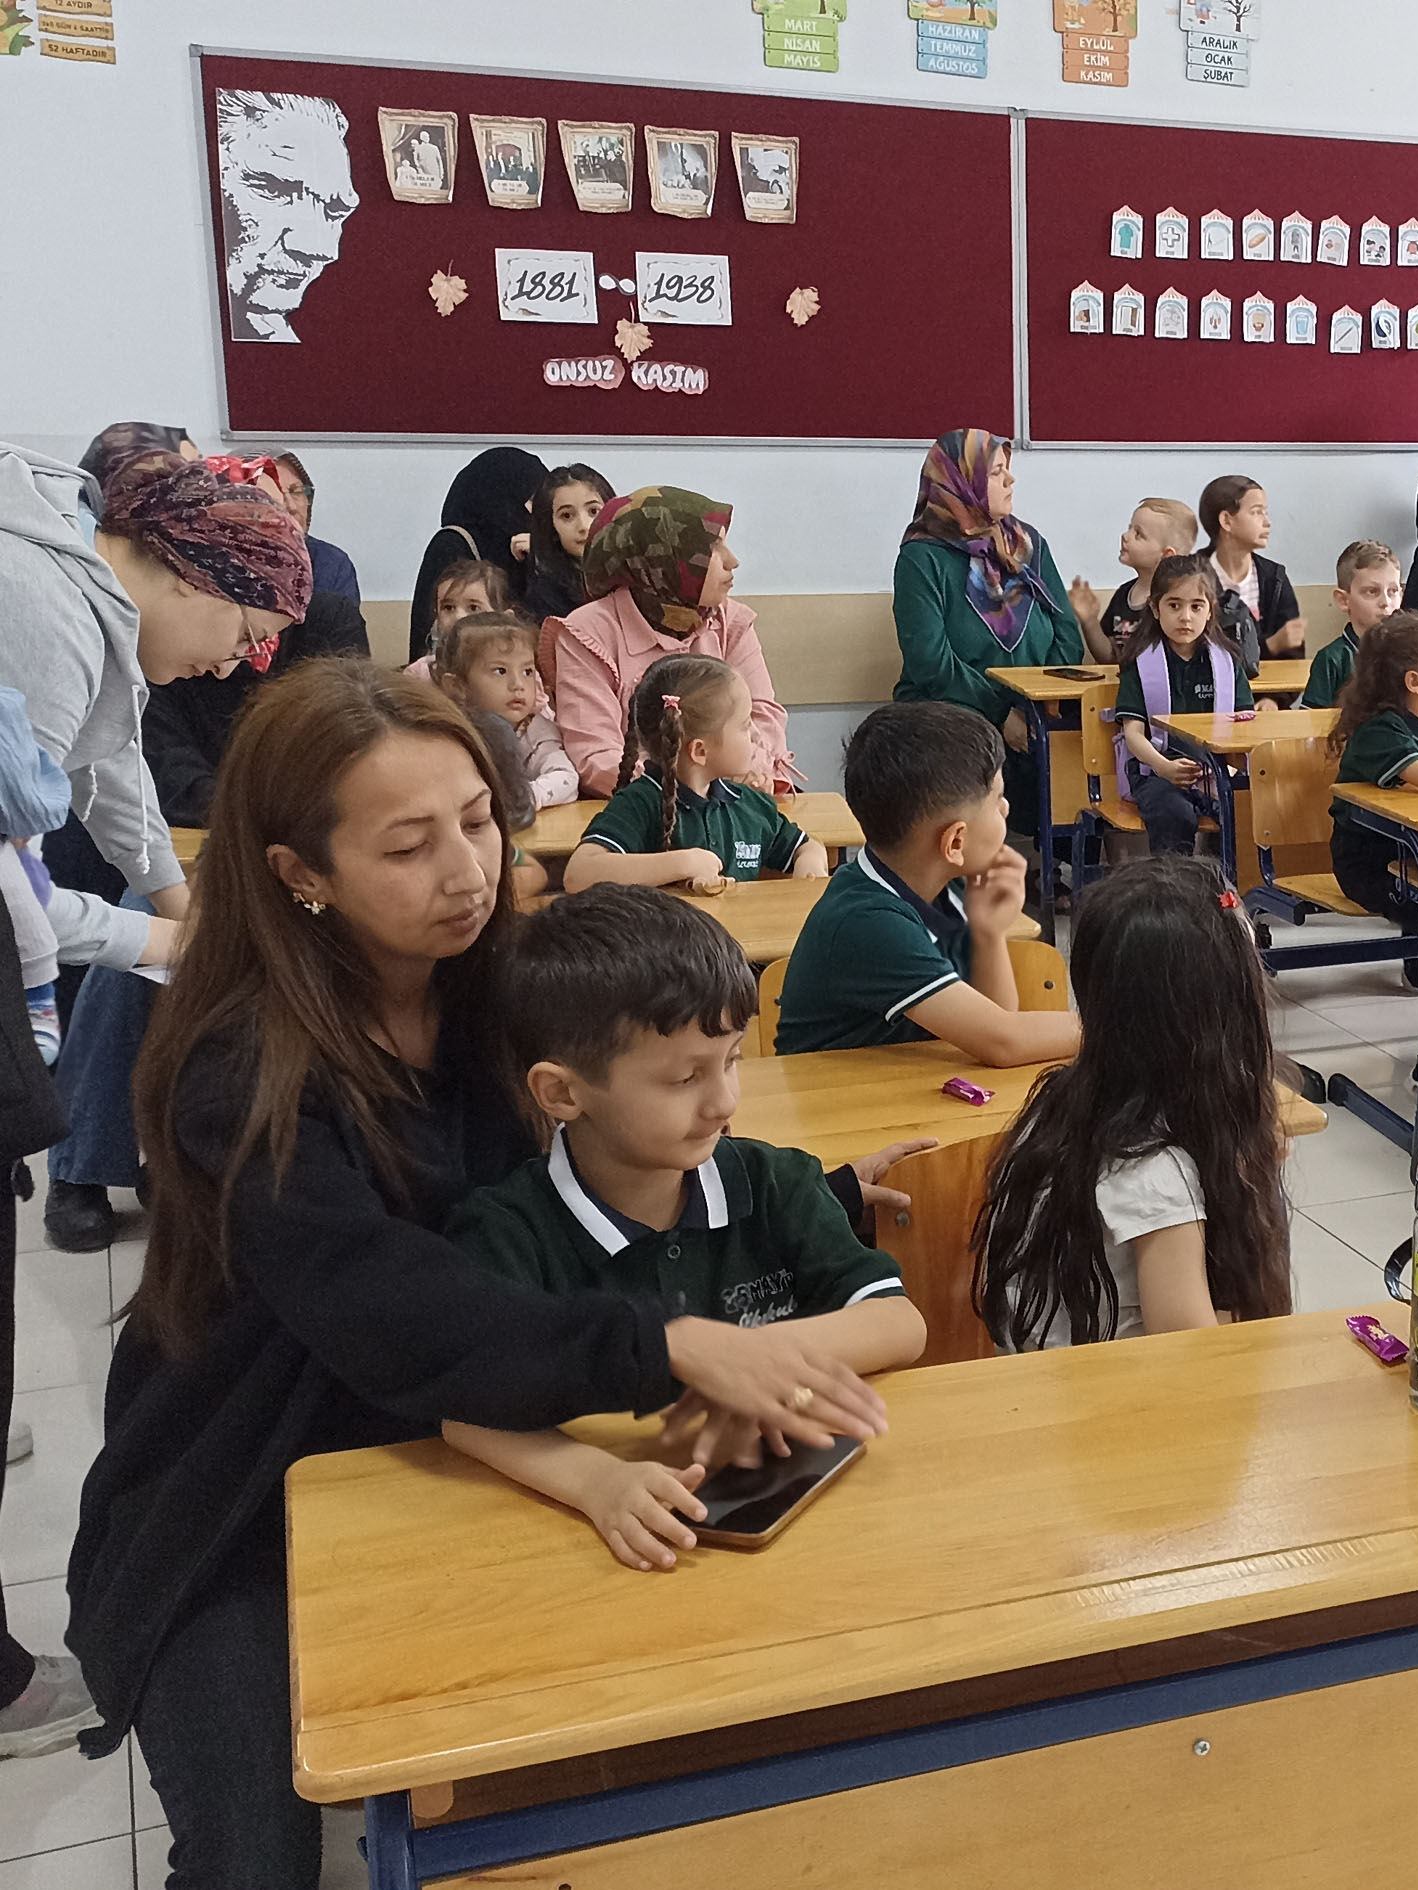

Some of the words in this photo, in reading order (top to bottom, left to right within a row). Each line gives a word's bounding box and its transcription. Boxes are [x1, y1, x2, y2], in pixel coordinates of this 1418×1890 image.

[66, 0, 93, 9] AYDIR
[784, 19, 817, 32] MART
[48, 43, 59, 53] 52
[61, 46, 107, 58] HAFTADIR
[929, 41, 977, 57] TEMMUZ
[1201, 36, 1238, 50] ARALIK
[784, 53, 821, 68] MAYIS
[1205, 52, 1233, 66] OCAK
[1080, 69, 1113, 83] KASIM
[510, 269, 580, 303] 1881
[648, 272, 716, 305] 1938
[545, 358, 616, 382] ONSUZ
[631, 361, 706, 390] KASIM
